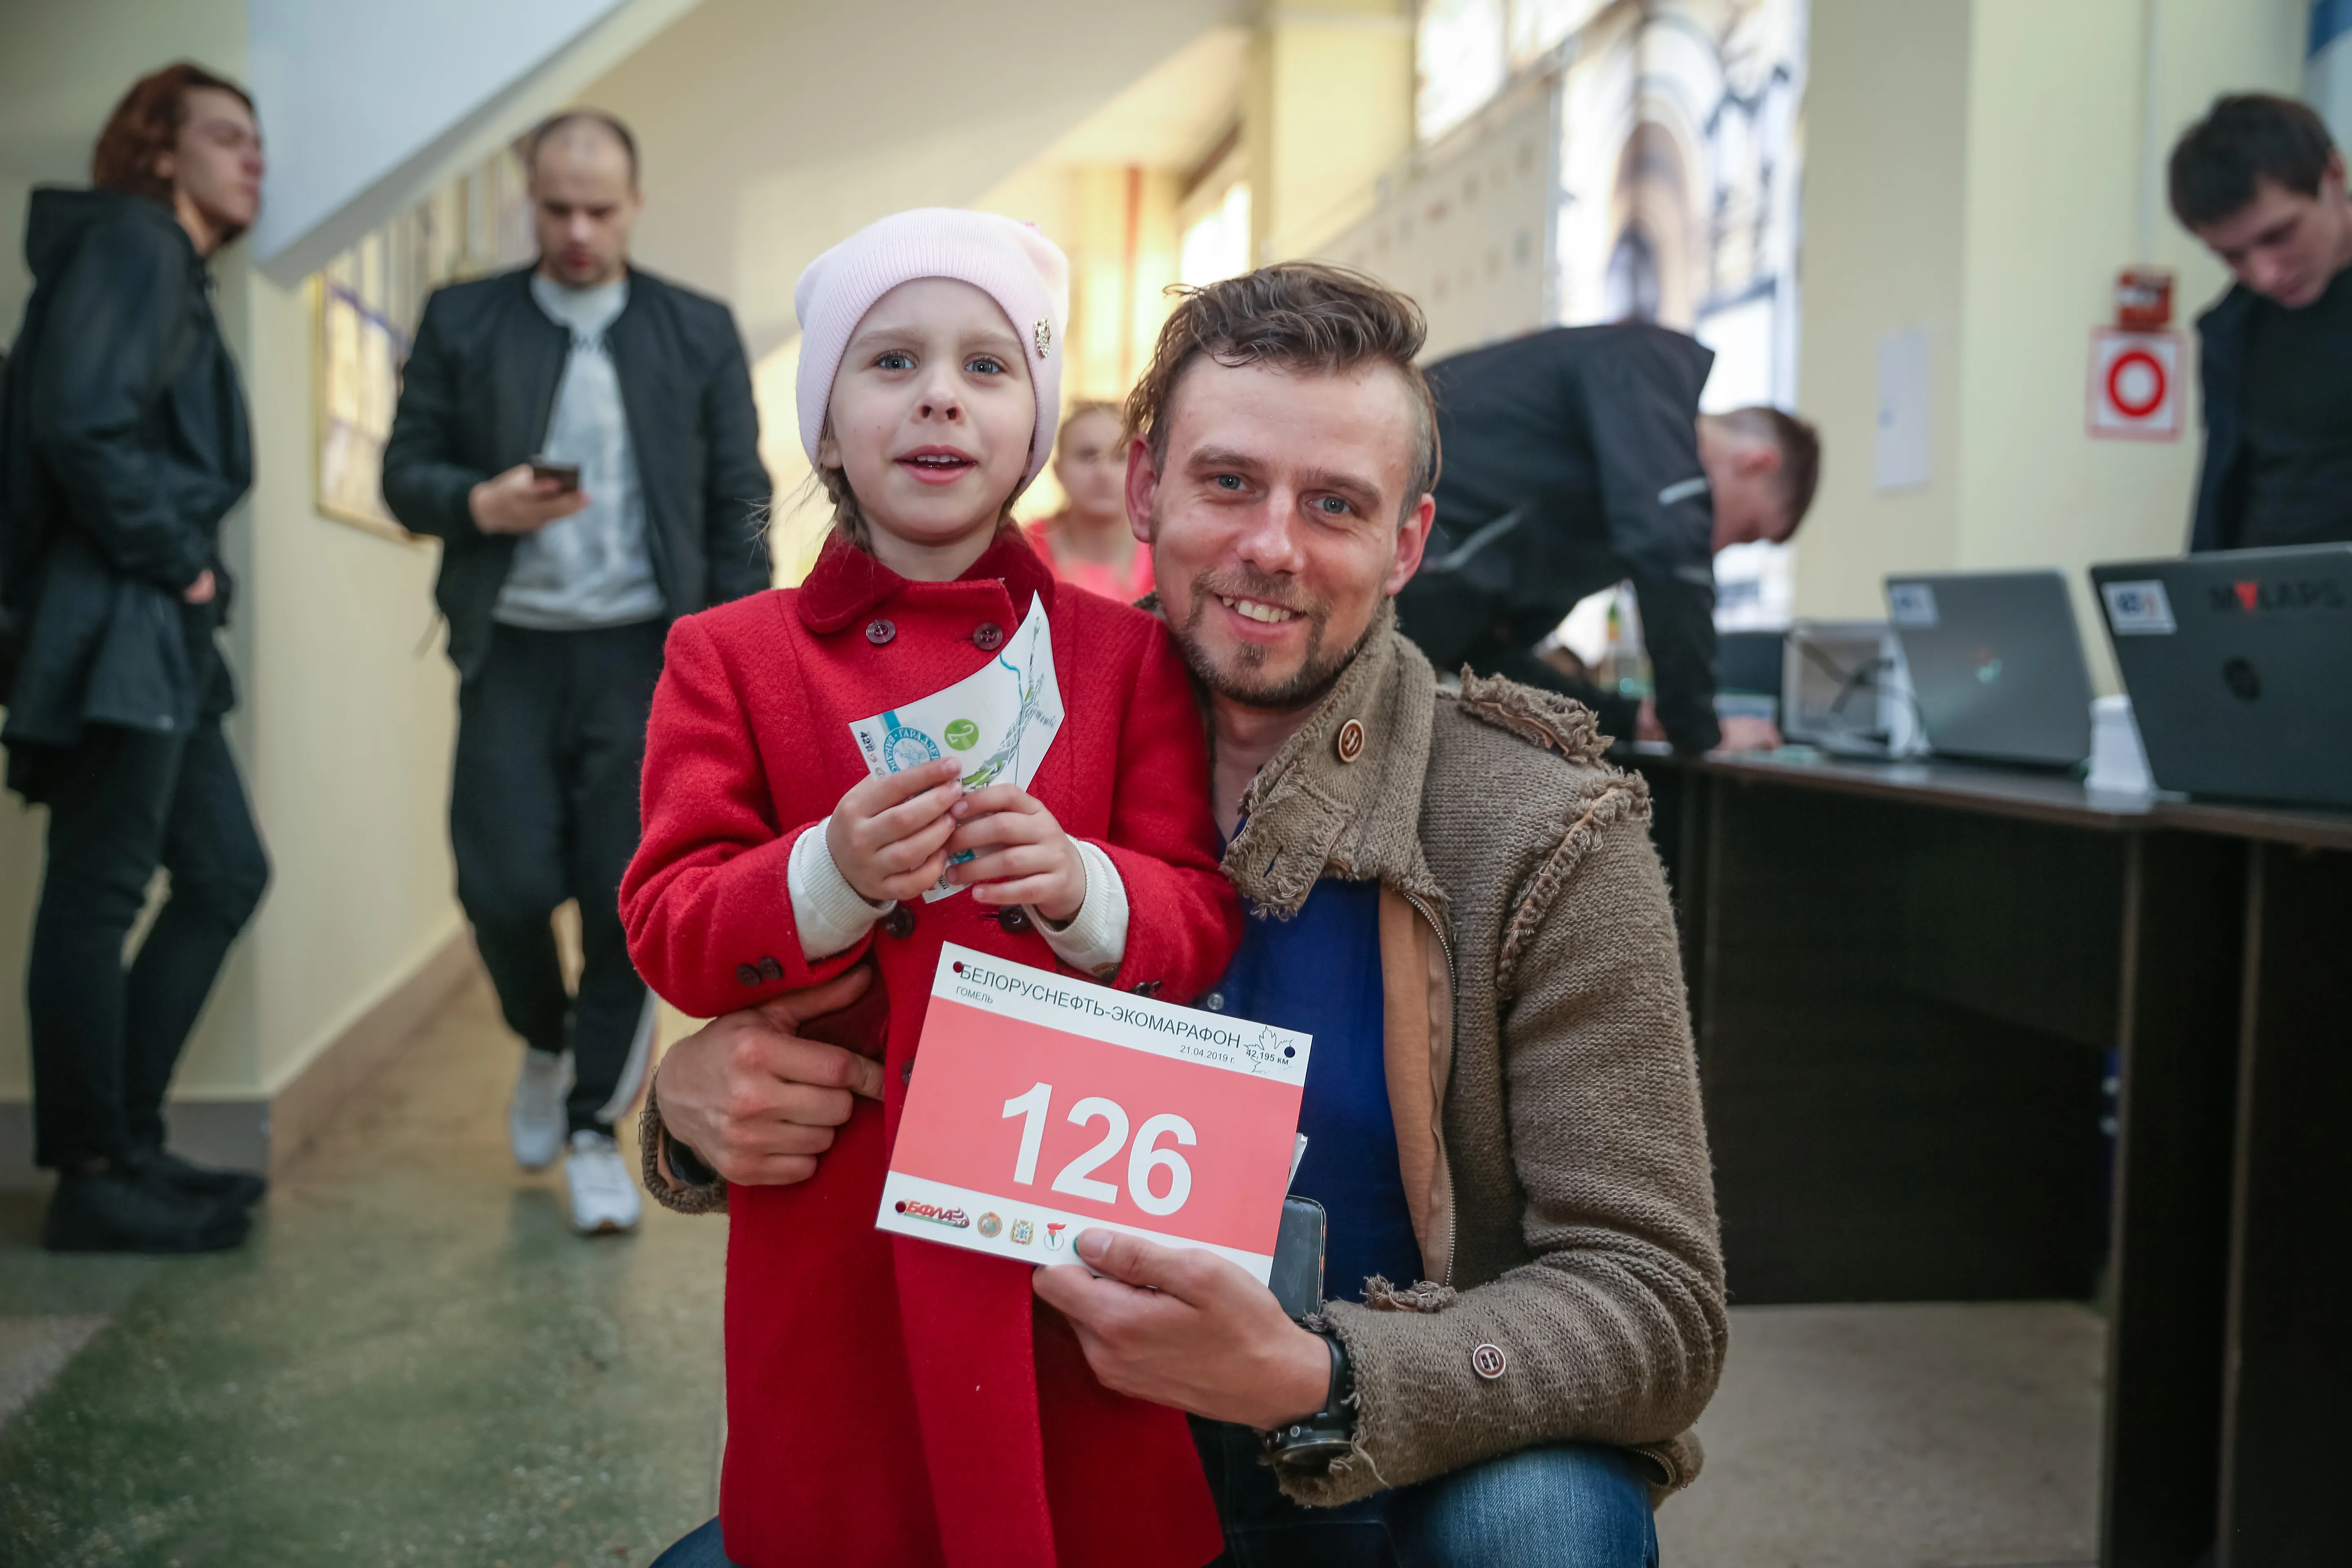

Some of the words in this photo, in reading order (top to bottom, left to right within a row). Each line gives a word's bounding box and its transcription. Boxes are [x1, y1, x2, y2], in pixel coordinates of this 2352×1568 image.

[956, 985, 993, 1004] ГОМЕЛЬ
[960, 963, 1241, 1048] БЕЛОРУСНЕФТЬ-ЭКОМАРАФОН
[1180, 1045, 1228, 1062] 21.04.2019
[1230, 1056, 1235, 1064] г.
[1245, 1049, 1275, 1062] 42,195
[1002, 1081, 1197, 1216] 126
[906, 1200, 953, 1221] БФЛА
